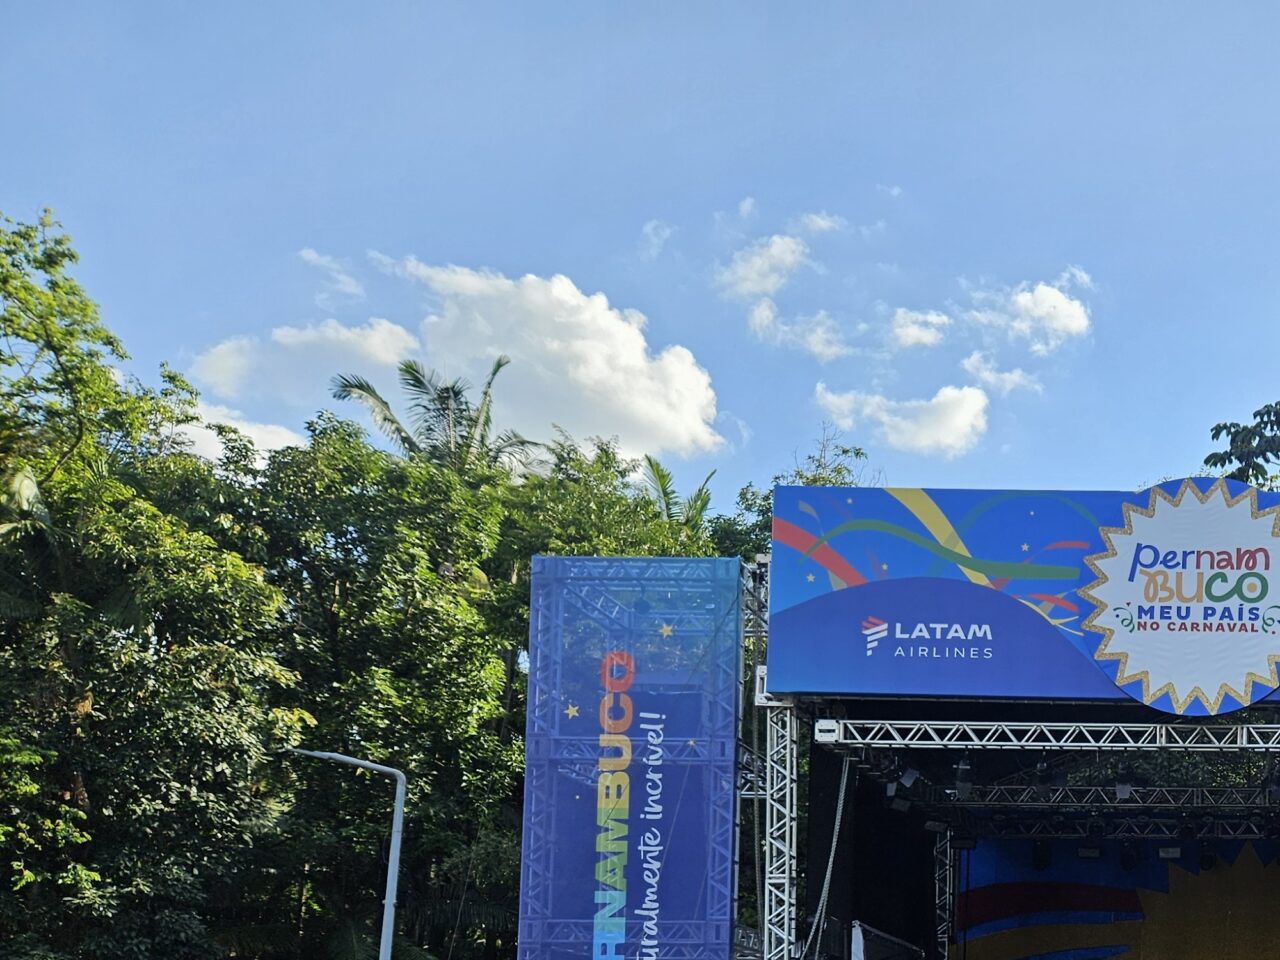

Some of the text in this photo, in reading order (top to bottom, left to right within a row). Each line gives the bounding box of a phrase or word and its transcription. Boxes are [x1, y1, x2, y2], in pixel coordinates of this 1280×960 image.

[1137, 604, 1260, 621] MEU PAÍS
[895, 622, 992, 640] LATAM
[1137, 622, 1258, 632] NO CARNAVAL
[894, 646, 992, 658] AIRLINES
